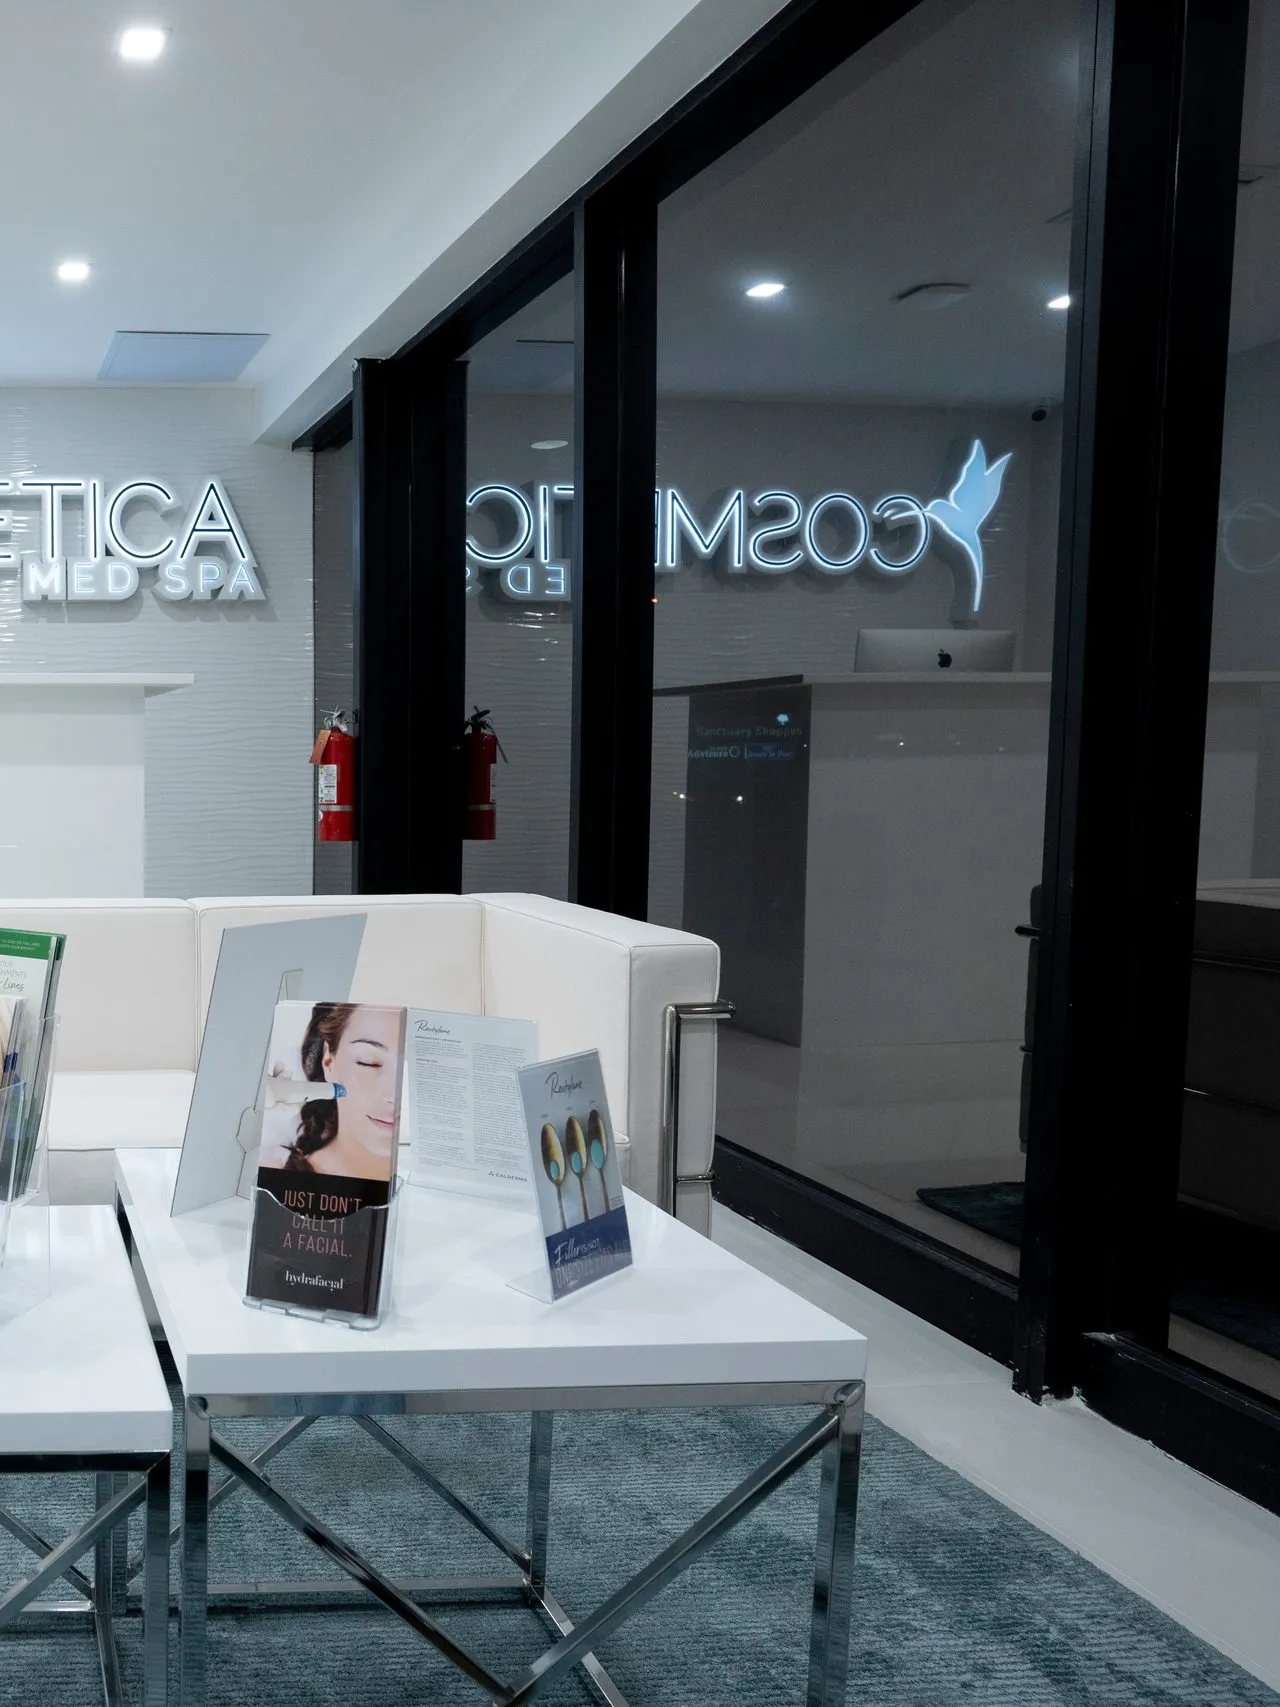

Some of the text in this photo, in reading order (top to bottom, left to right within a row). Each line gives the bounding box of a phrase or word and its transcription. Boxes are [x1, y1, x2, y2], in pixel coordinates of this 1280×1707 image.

[28, 562, 256, 594] MED SPA
[3, 977, 24, 992] Lines
[282, 1189, 362, 1214] JUST DON'T
[292, 1212, 327, 1233] CALL
[283, 1231, 352, 1258] A FACIAL.
[285, 1270, 344, 1292] hydrafacial
